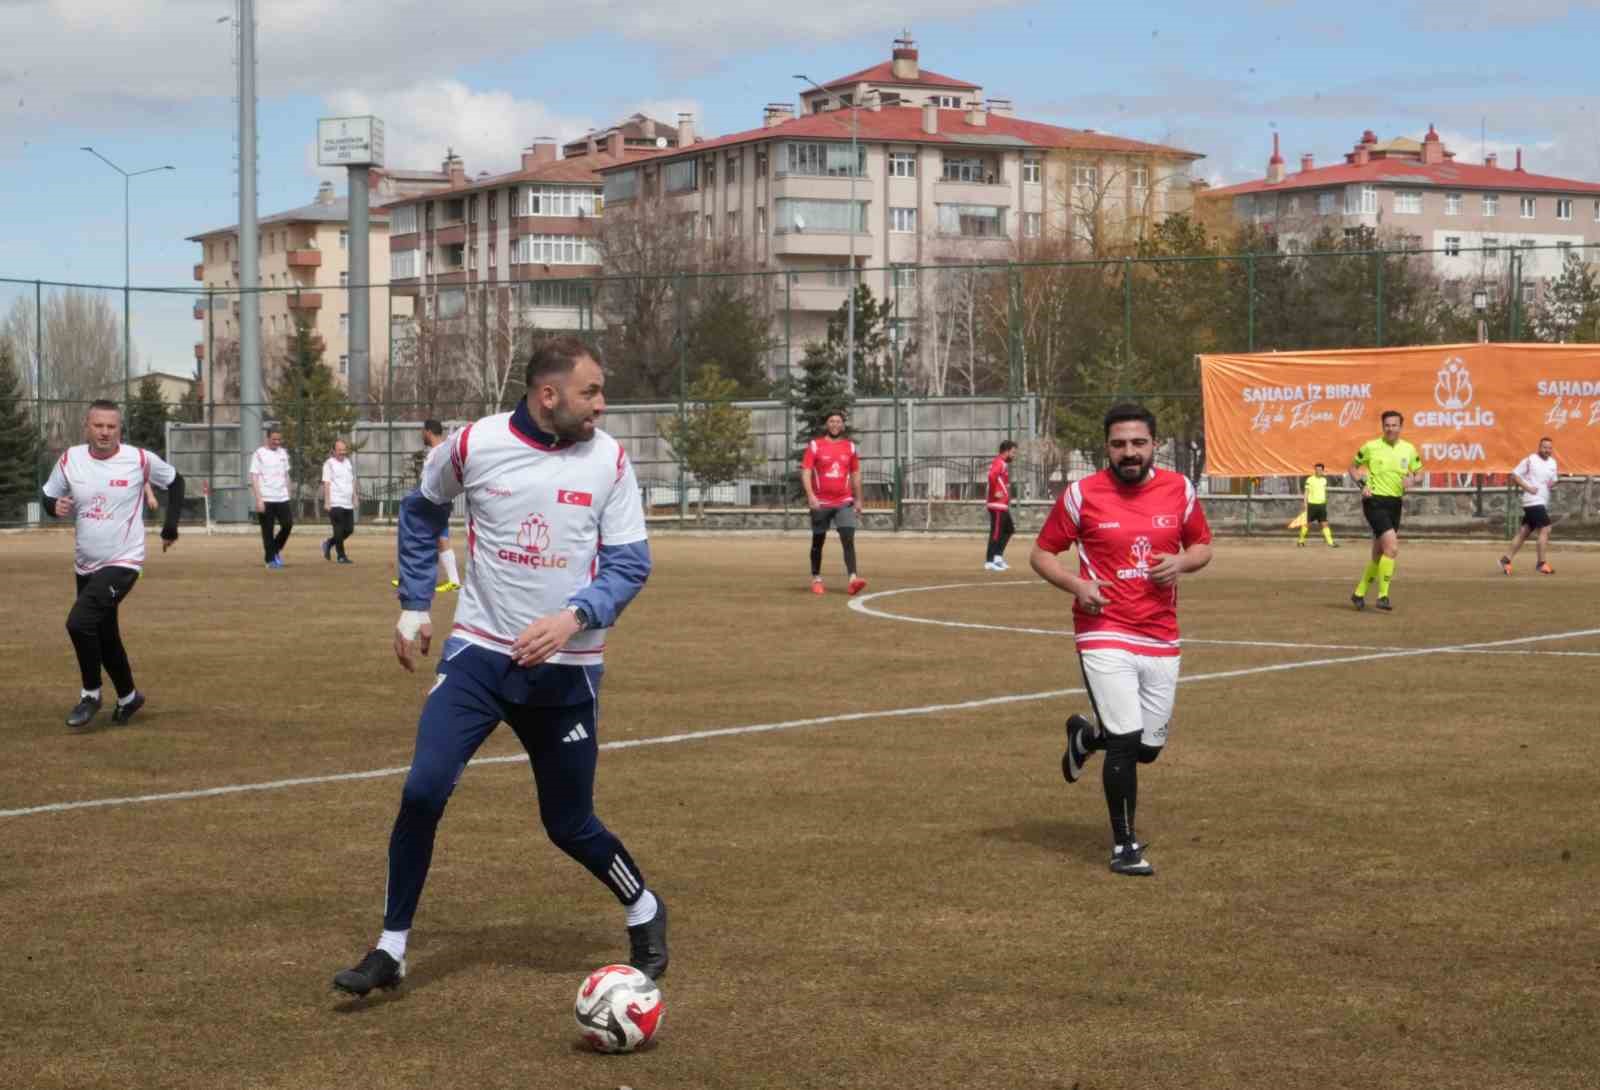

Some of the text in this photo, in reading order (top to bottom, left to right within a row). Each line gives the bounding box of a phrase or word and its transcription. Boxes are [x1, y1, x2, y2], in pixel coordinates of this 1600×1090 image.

[1242, 386, 1304, 402] SAHADA
[1325, 383, 1372, 400] BIRAK
[498, 549, 567, 570] GENÇLİG
